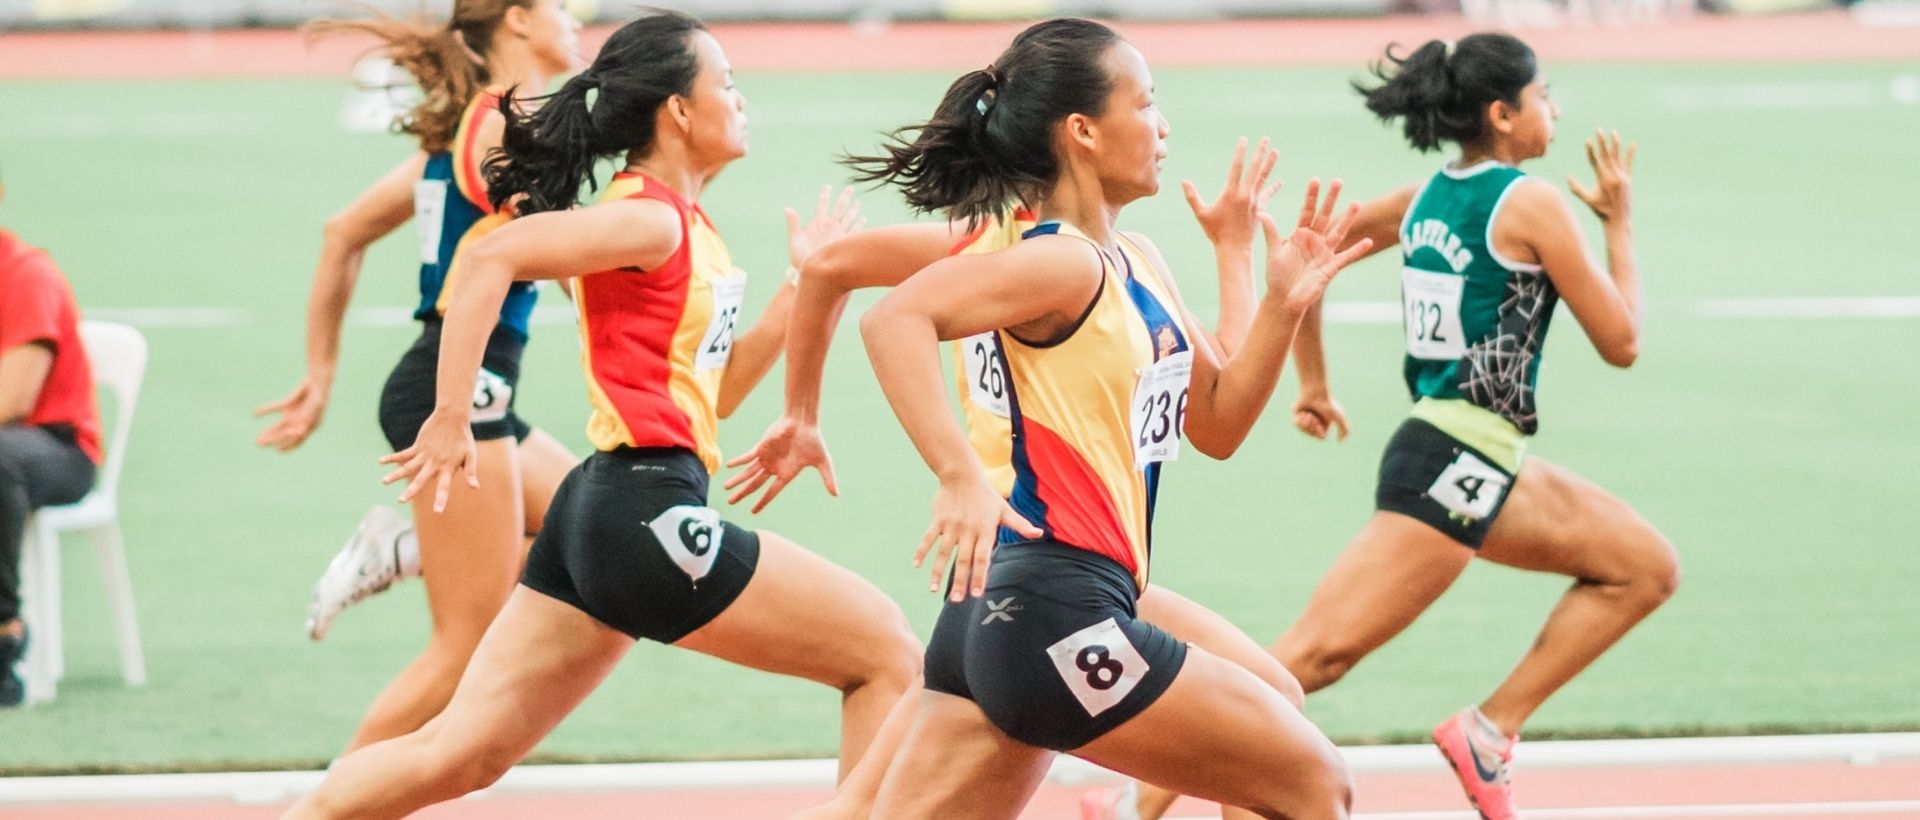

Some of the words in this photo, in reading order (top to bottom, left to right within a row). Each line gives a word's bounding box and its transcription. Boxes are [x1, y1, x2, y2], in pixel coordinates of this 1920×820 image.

[975, 341, 1007, 400] 26
[473, 376, 495, 411] 3
[1454, 475, 1486, 505] 4
[678, 517, 713, 557] 6
[1075, 644, 1124, 691] 8
